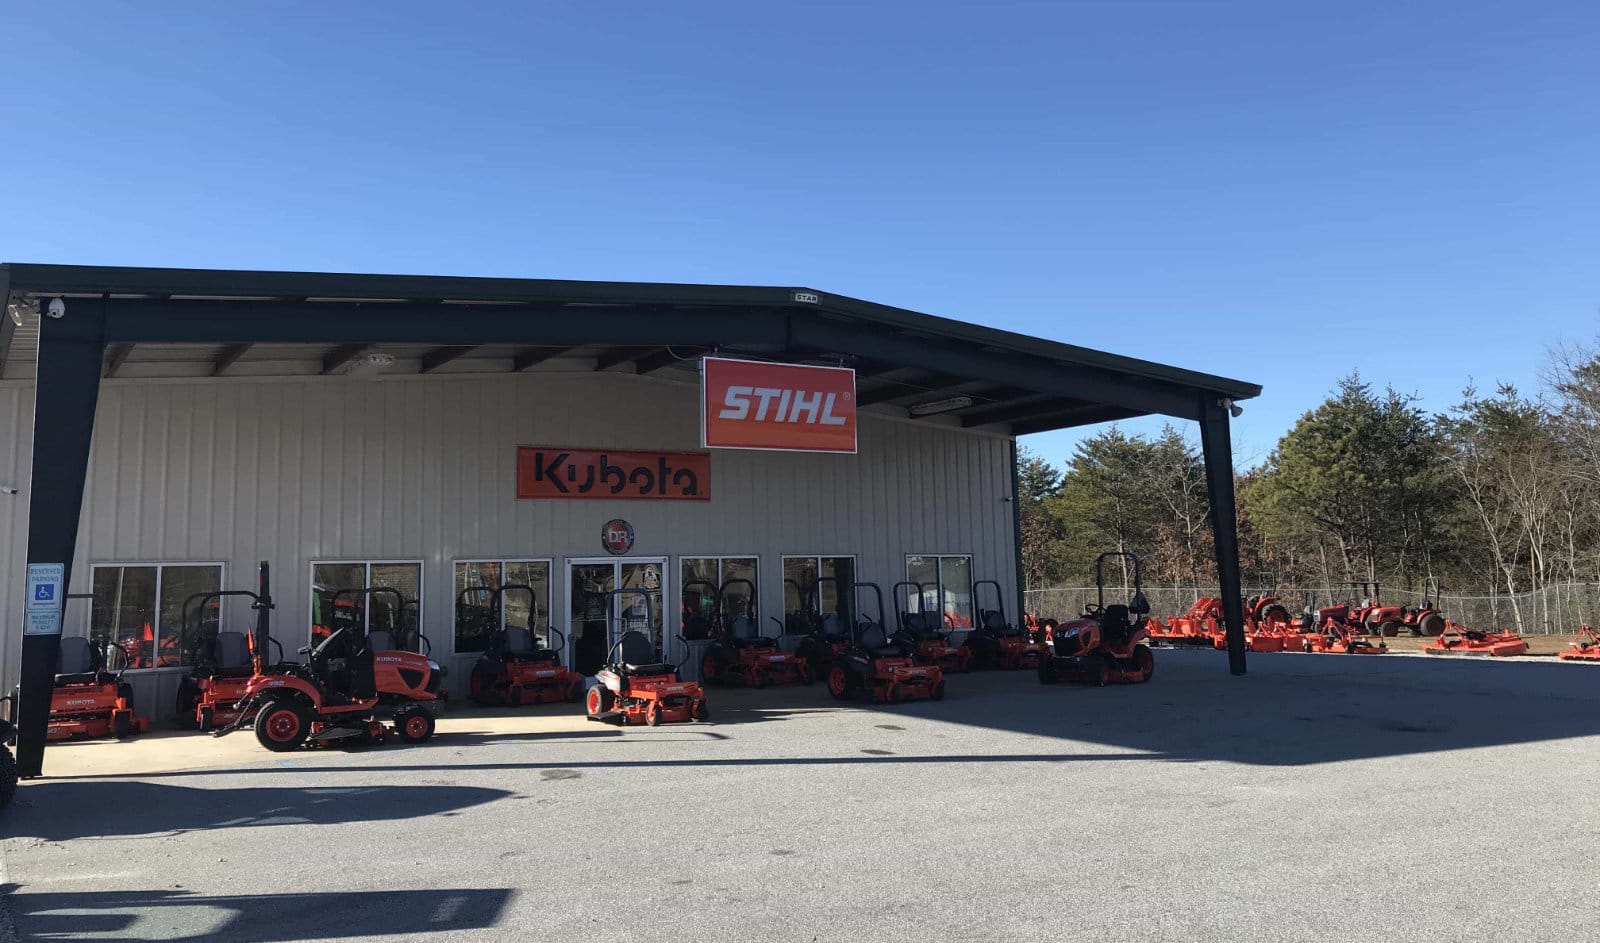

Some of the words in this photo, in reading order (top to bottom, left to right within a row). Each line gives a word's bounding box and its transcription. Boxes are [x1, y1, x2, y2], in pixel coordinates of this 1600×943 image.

[797, 294, 817, 302] STAR
[718, 385, 847, 427] STIHL
[534, 452, 698, 496] Kubota
[607, 530, 628, 543] DR
[30, 567, 61, 575] RESERVED
